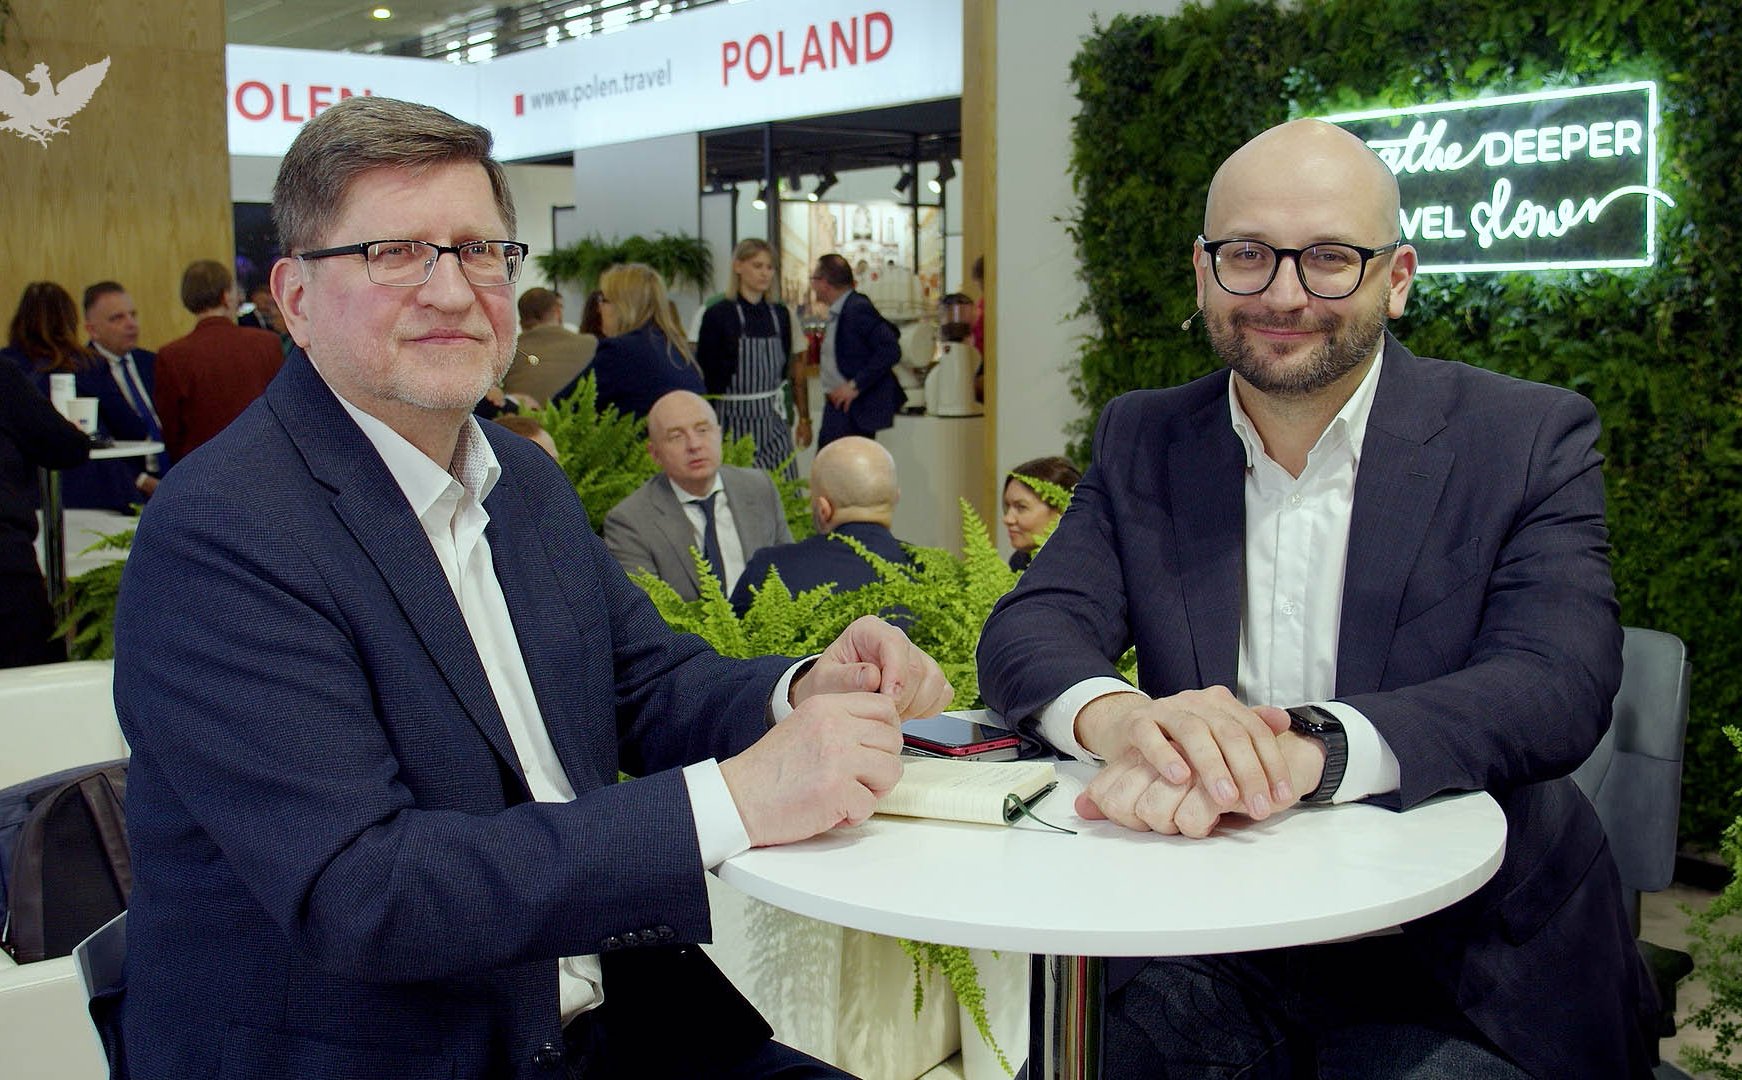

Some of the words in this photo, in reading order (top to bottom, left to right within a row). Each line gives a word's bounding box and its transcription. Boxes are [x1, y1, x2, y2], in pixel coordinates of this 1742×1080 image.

[722, 11, 894, 87] POLAND
[226, 80, 373, 122] OLE
[531, 58, 672, 110] www.polen.travel
[1366, 118, 1486, 175] athe
[1484, 119, 1643, 167] DEEPER
[1400, 205, 1467, 240] VEL
